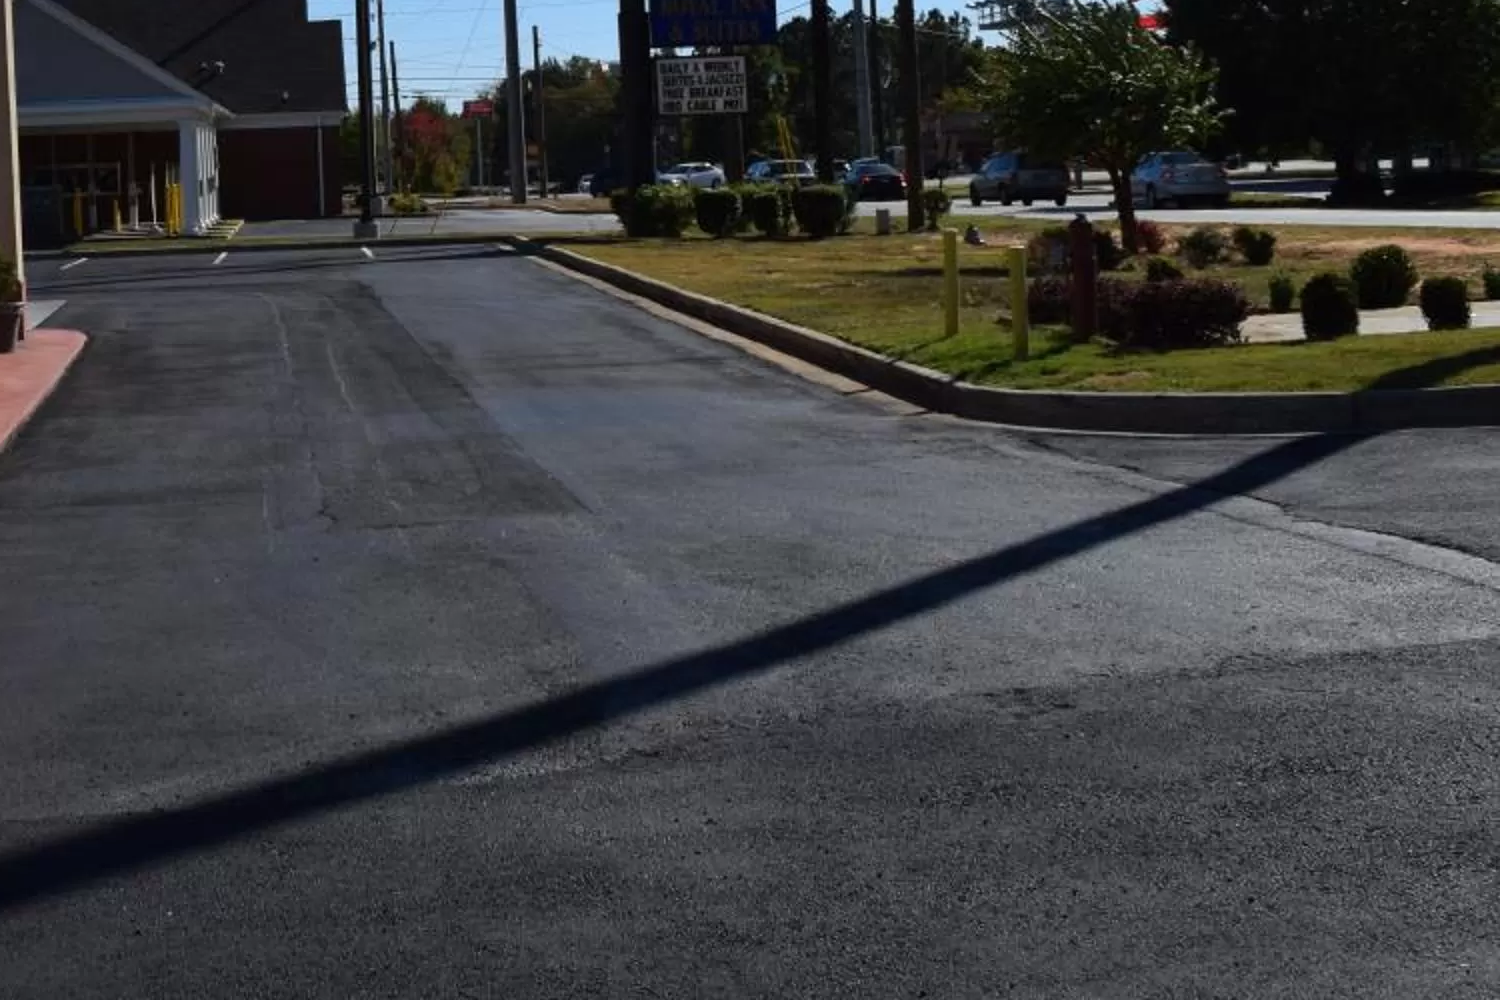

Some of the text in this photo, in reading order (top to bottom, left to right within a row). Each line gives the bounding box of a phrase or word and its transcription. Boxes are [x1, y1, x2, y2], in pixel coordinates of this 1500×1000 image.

[695, 19, 758, 40] SUITES
[660, 62, 689, 74] DAILY
[704, 60, 740, 73] WEEKLY
[689, 86, 744, 98] BREAKFAST
[687, 100, 716, 111] CABLE
